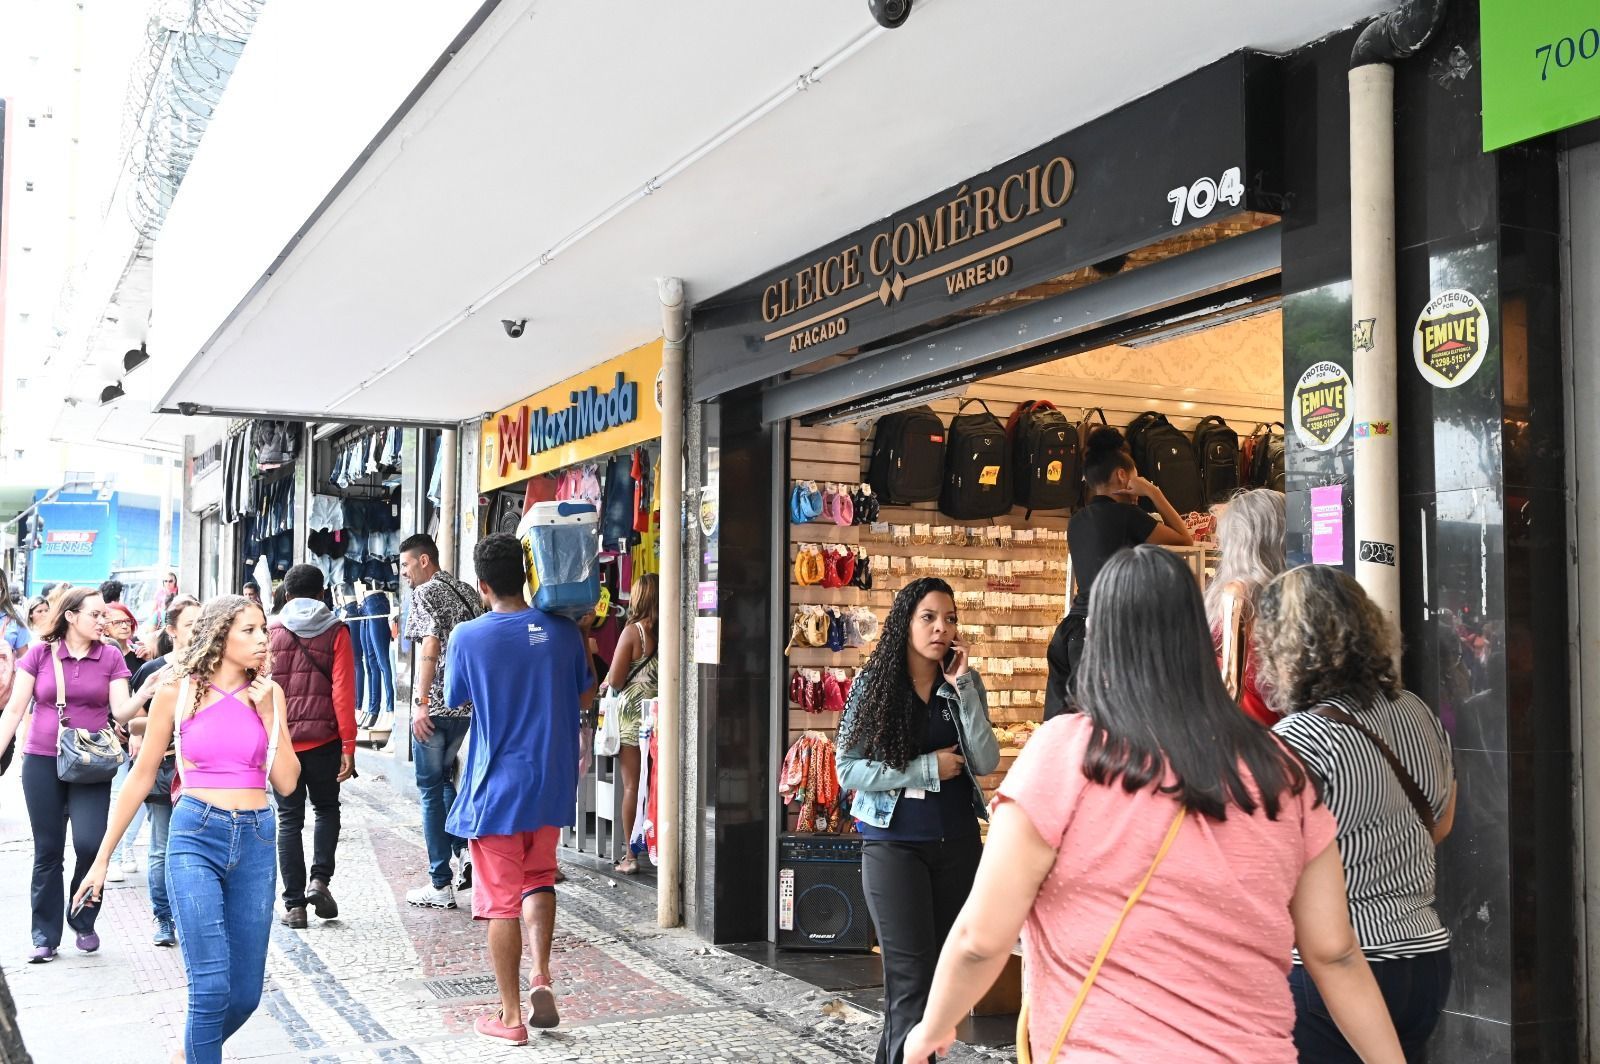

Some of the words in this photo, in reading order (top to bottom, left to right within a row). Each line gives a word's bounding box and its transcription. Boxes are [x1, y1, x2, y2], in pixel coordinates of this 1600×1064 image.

[1535, 28, 1600, 81] 700
[1167, 166, 1245, 226] 704
[762, 245, 863, 323] GLEICE
[869, 156, 1075, 276] COMÉRCIO
[945, 255, 1013, 295] VAREJO
[1426, 292, 1474, 315] PROTEGIDO
[1442, 302, 1455, 310] POR
[789, 317, 848, 353] ATACADO
[1425, 316, 1476, 353] EMIVE
[1302, 363, 1342, 384] PROTEGIDO
[1435, 353, 1467, 368] 3298-5151
[1301, 385, 1343, 418] EMIVE
[1310, 418, 1336, 431] 3298-5151
[47, 542, 93, 553] TENNIS
